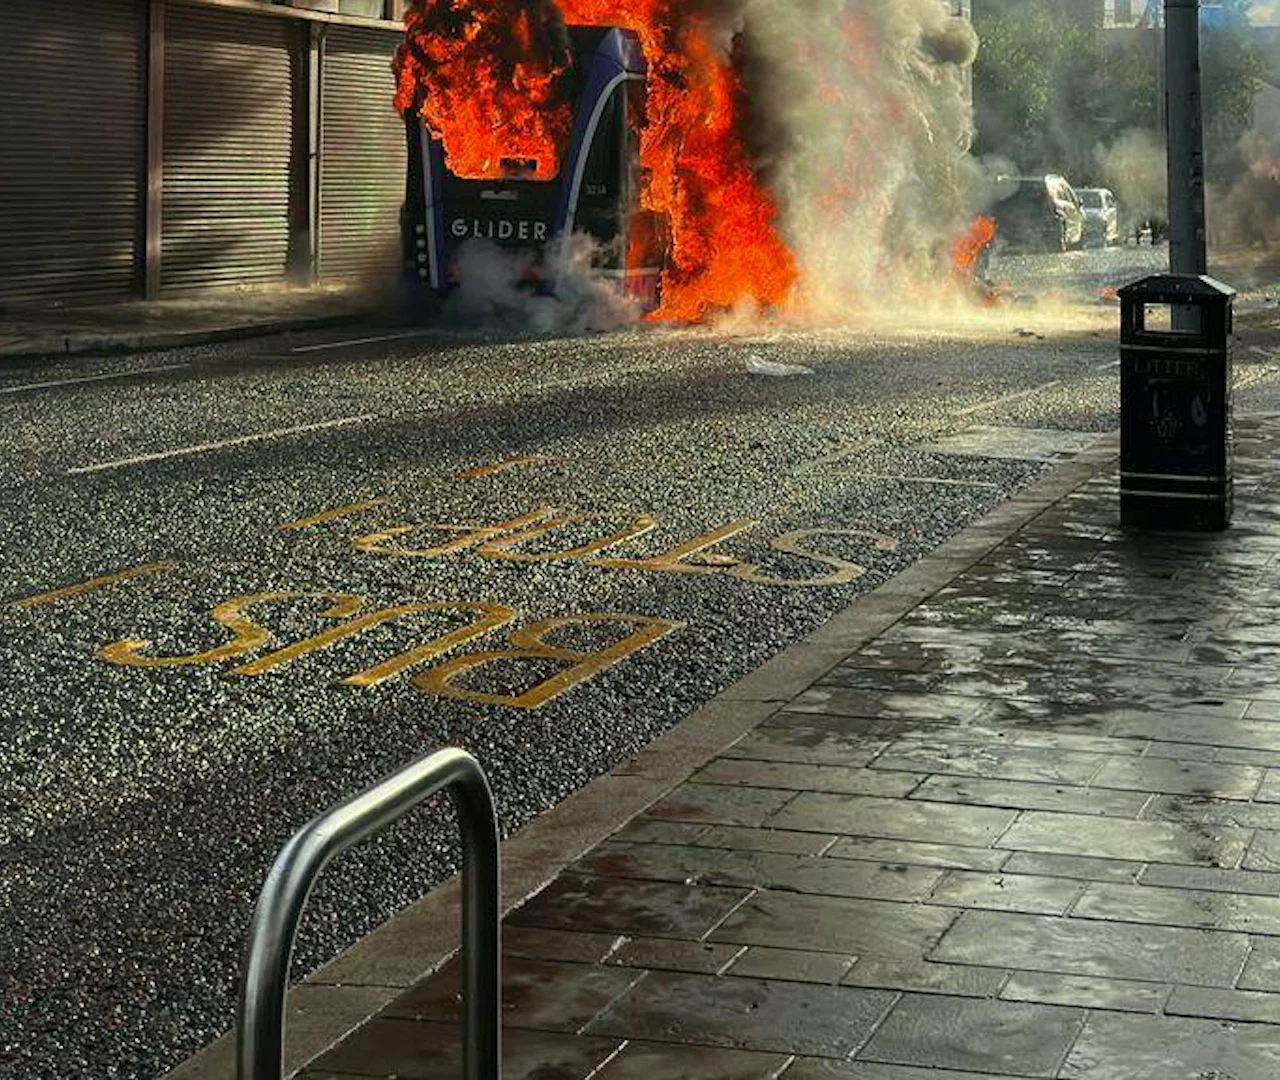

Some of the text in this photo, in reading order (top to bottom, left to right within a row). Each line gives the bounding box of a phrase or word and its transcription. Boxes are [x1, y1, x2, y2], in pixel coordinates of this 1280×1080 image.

[451, 218, 548, 241] GLIDER
[355, 505, 898, 586] STOP
[97, 591, 690, 709] BUS
